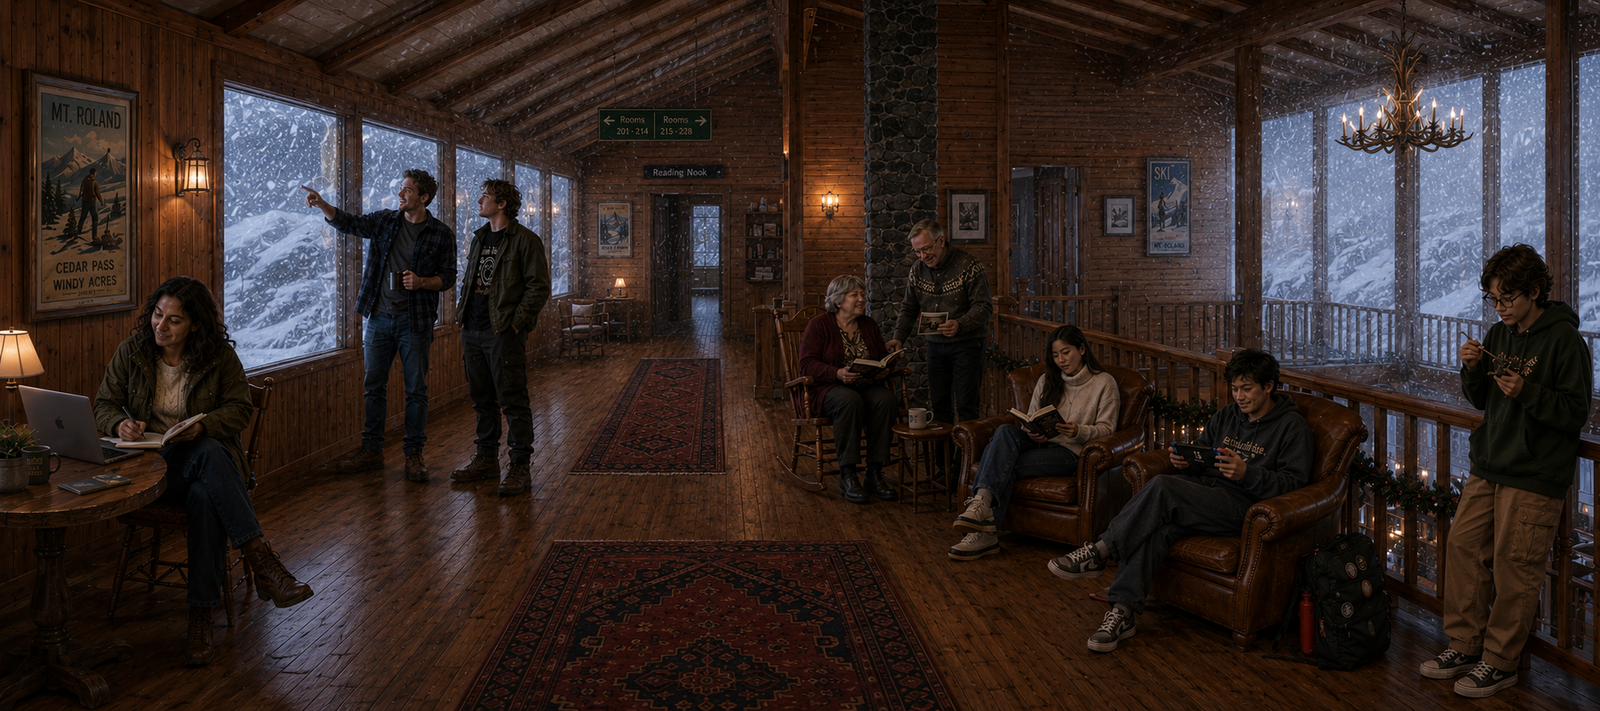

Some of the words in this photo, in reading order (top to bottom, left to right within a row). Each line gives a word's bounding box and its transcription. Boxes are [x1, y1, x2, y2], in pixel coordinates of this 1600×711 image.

[51, 101, 73, 123] MT.
[77, 106, 121, 129] ROLAND
[620, 115, 645, 124] Rooms
[663, 115, 689, 124] Rooms
[652, 168, 684, 178] Reading
[686, 168, 708, 177] Nook
[1154, 166, 1170, 180] SKI
[56, 261, 88, 274] CEDAR
[92, 259, 115, 271] PASS
[53, 277, 85, 291] WINDY
[88, 275, 117, 288] ACRES
